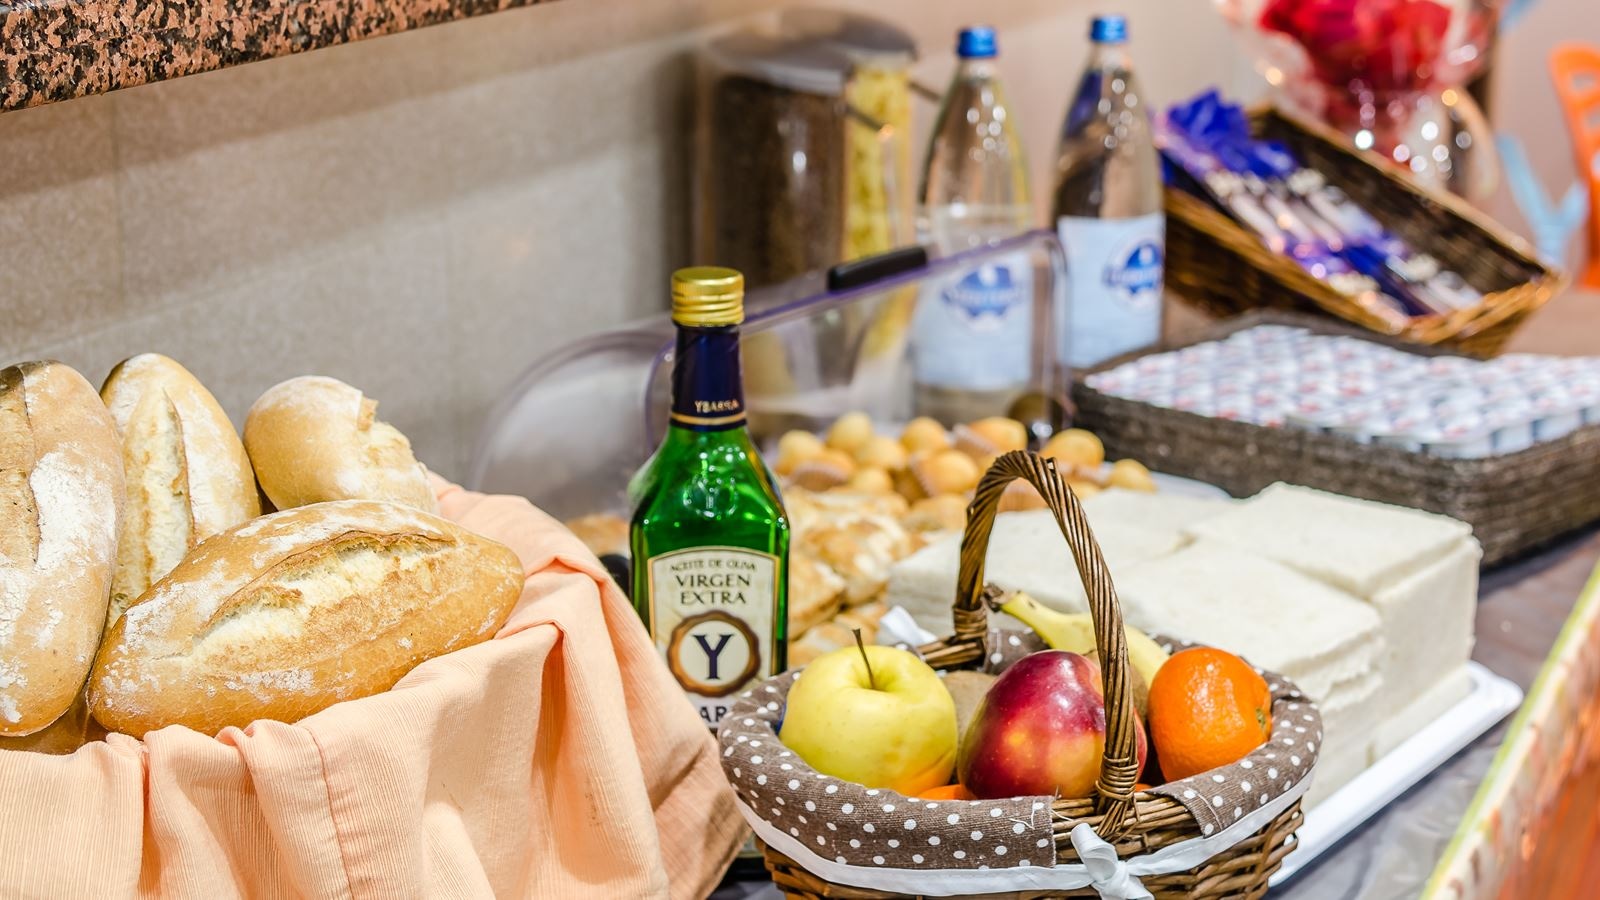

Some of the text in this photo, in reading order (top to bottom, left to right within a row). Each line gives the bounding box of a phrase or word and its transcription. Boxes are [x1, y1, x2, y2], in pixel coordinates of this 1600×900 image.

[670, 559, 757, 572] ACEITE DE OLIVA
[675, 573, 751, 588] VIRGEN
[680, 590, 747, 605] EXTRA
[692, 633, 735, 680] Y
